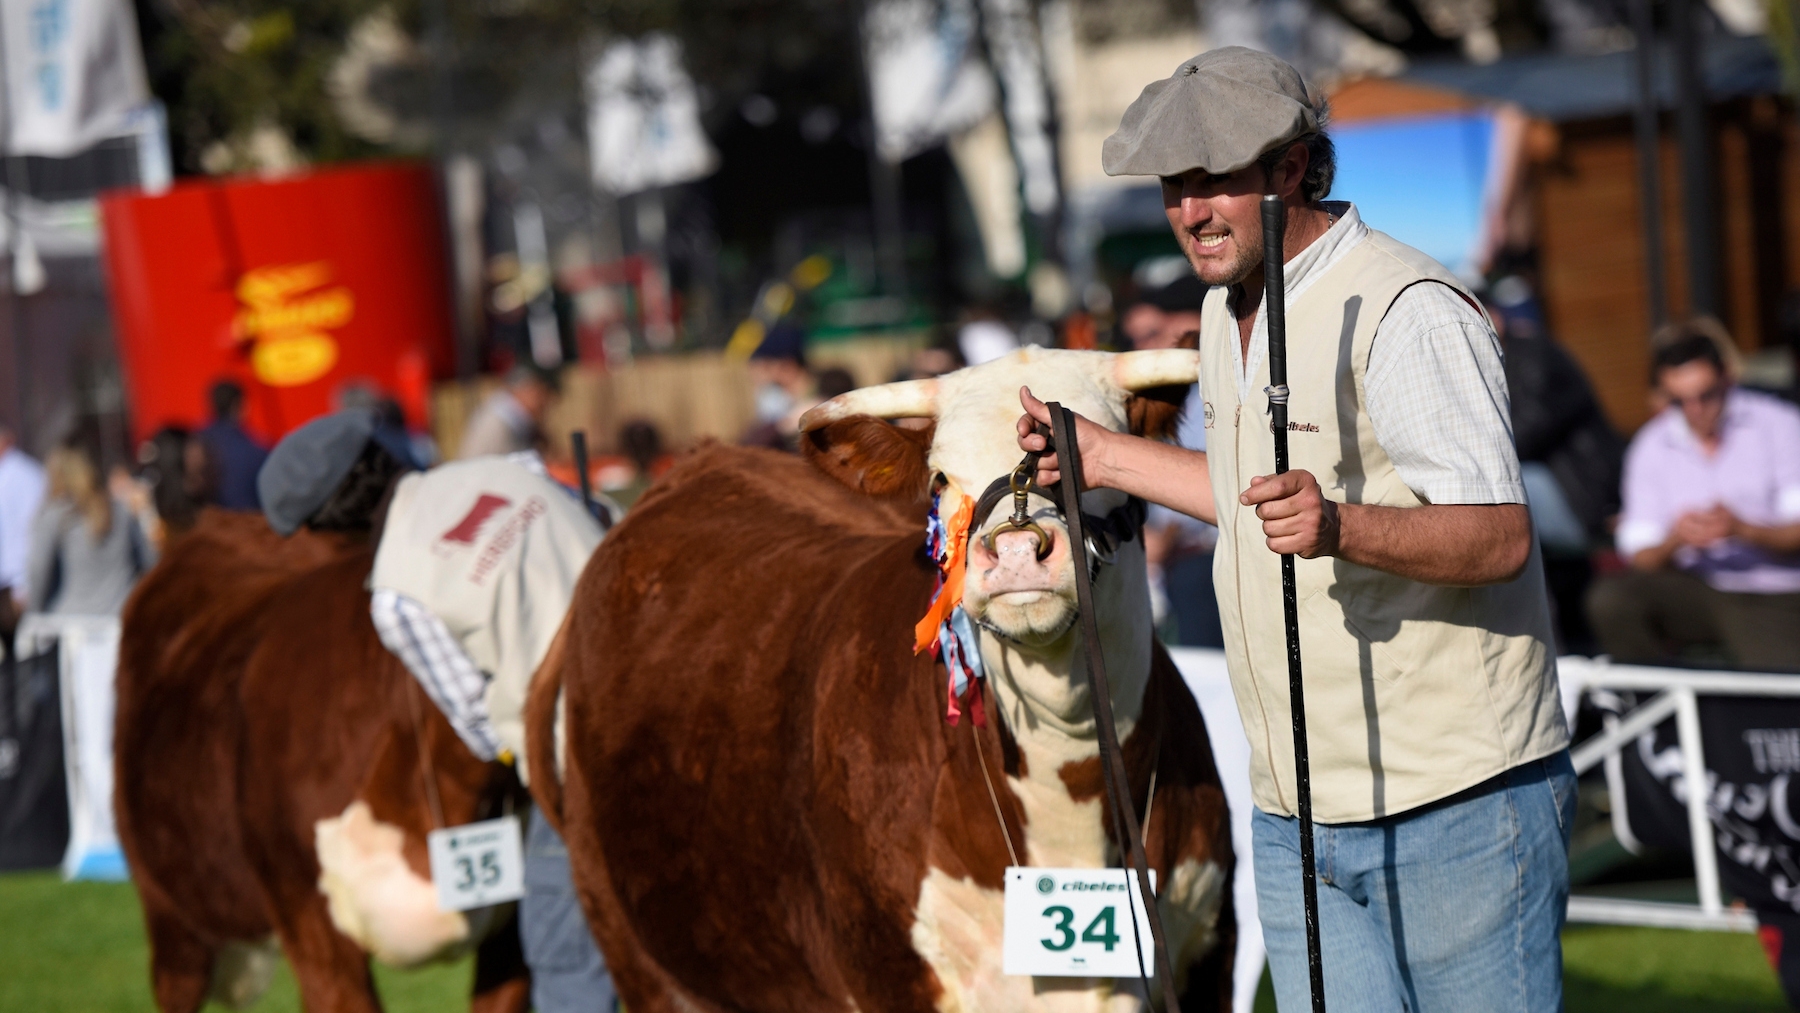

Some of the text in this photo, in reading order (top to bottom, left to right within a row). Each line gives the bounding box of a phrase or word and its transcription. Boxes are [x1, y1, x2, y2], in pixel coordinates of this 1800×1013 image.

[1287, 421, 1320, 433] ibeles
[454, 850, 502, 892] 35
[1062, 881, 1127, 892] cibeles
[1041, 905, 1120, 952] 34
